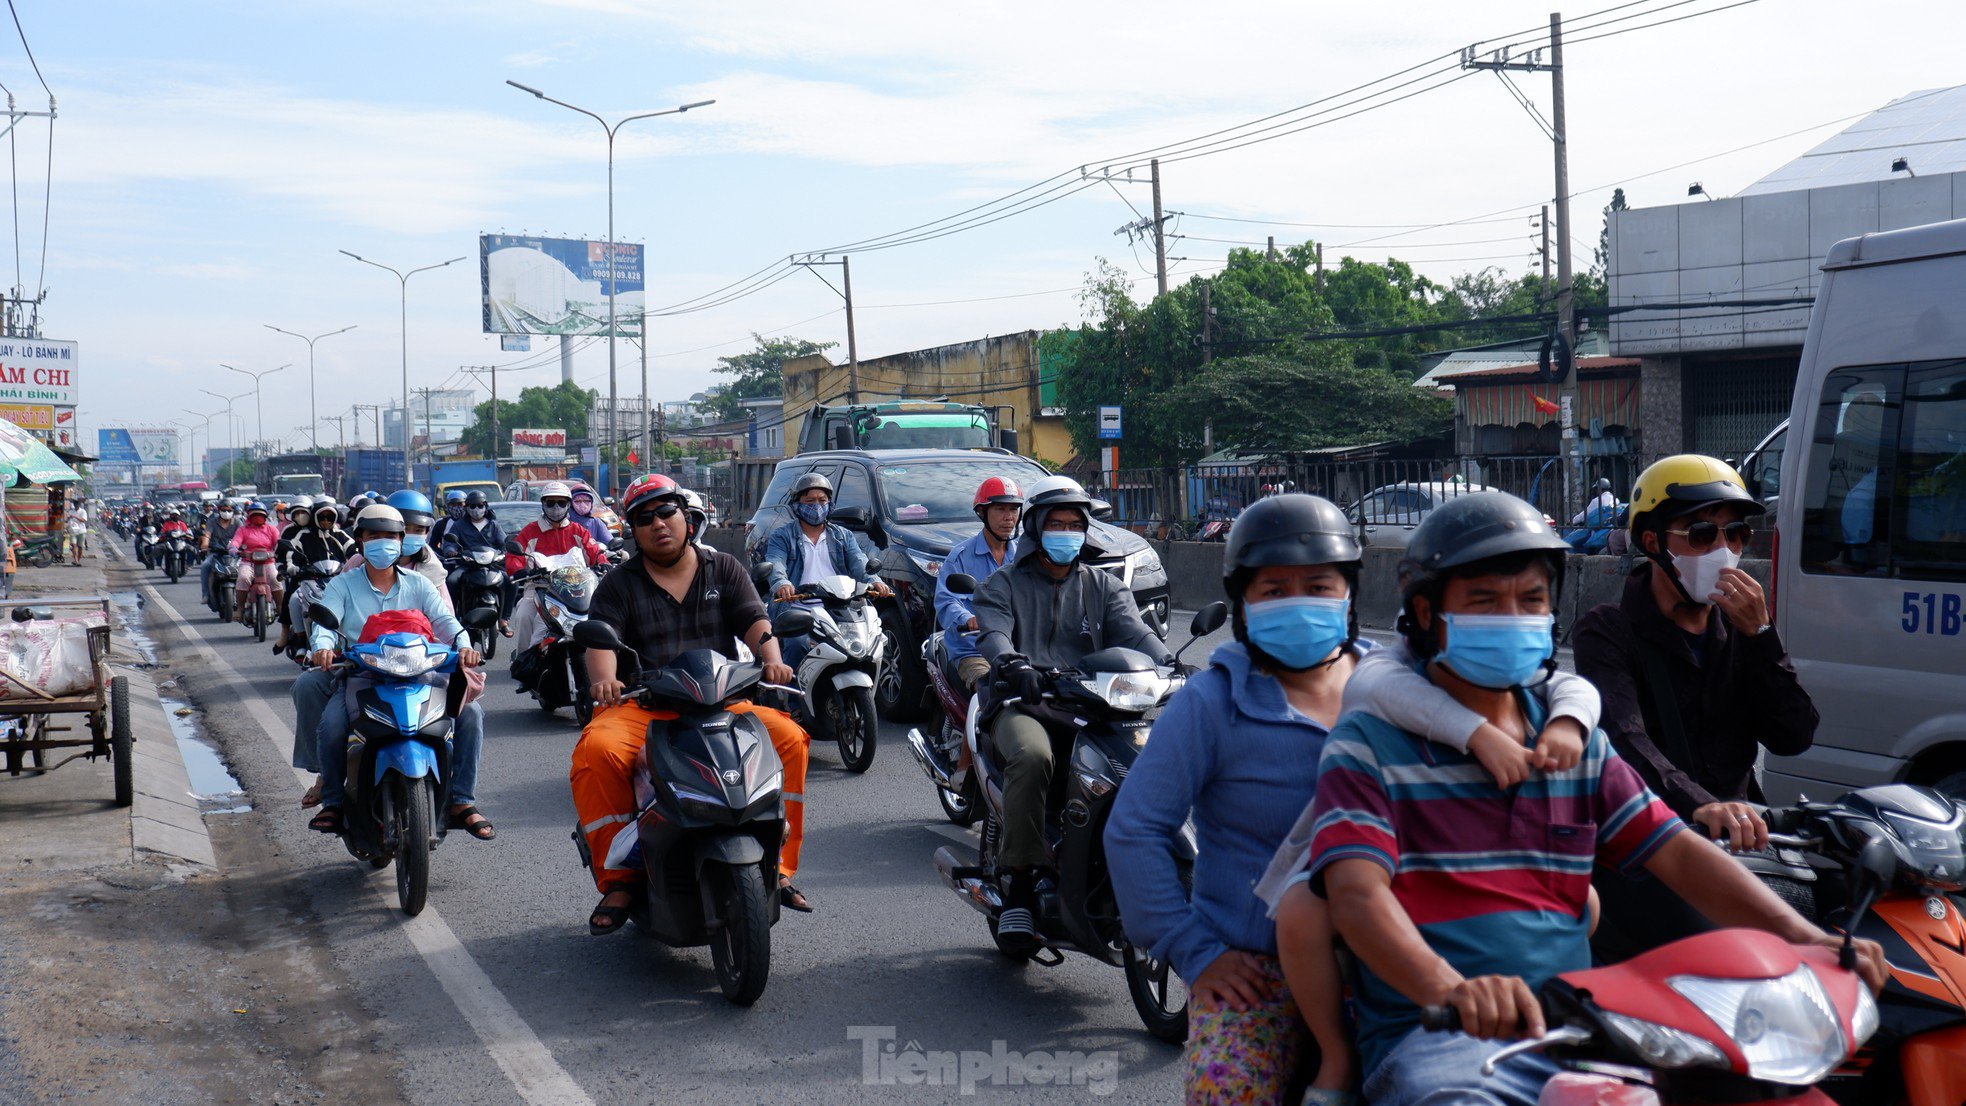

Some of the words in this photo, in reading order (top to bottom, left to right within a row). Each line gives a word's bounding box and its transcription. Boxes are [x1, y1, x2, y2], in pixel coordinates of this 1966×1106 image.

[22, 343, 33, 358] LÒ
[35, 344, 58, 360] BÁNH
[60, 346, 71, 360] MÌ
[33, 368, 71, 386] CHI
[27, 388, 58, 399] BÌNH
